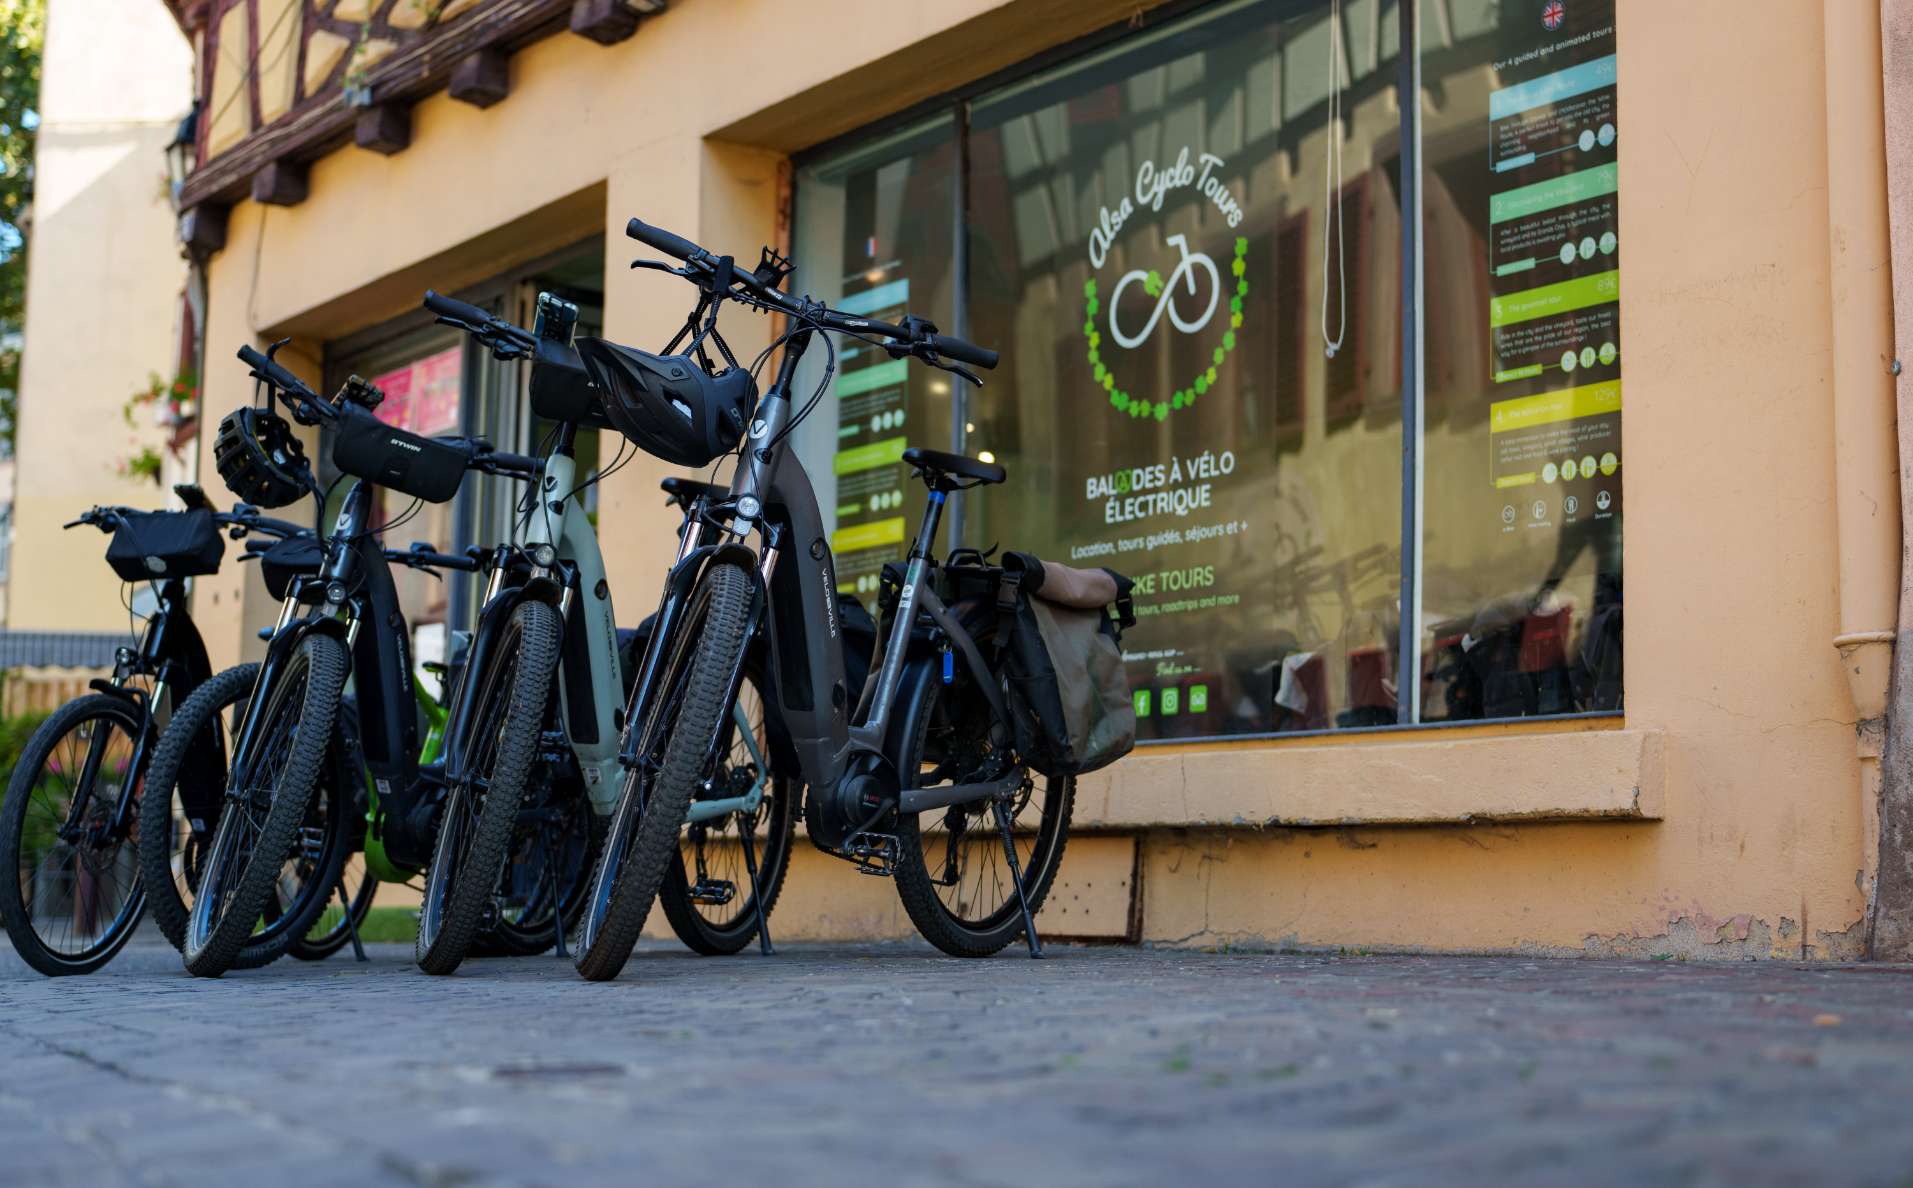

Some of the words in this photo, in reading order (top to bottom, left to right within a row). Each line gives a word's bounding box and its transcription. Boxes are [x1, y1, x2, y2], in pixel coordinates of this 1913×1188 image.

[1492, 61, 1506, 71] Our
[1508, 57, 1513, 65] 4
[1514, 49, 1539, 66] guided
[1540, 44, 1554, 55] and
[1555, 33, 1591, 51] animated
[1592, 26, 1612, 39] tours
[1089, 196, 1134, 270] Alsa
[1135, 146, 1195, 212] Cyclo
[1196, 153, 1243, 228] Tours
[1169, 457, 1182, 483] À
[1186, 450, 1236, 480] VÉLO
[1105, 484, 1212, 524] ÉLECTRIQUE
[1071, 541, 1117, 560] Location,
[1118, 535, 1145, 551] tours
[1146, 528, 1183, 551] guidés,
[1185, 524, 1224, 544] séjours
[1226, 521, 1239, 536] et
[1160, 565, 1215, 592] TOURS
[1200, 595, 1217, 608] and
[1217, 594, 1240, 605] more
